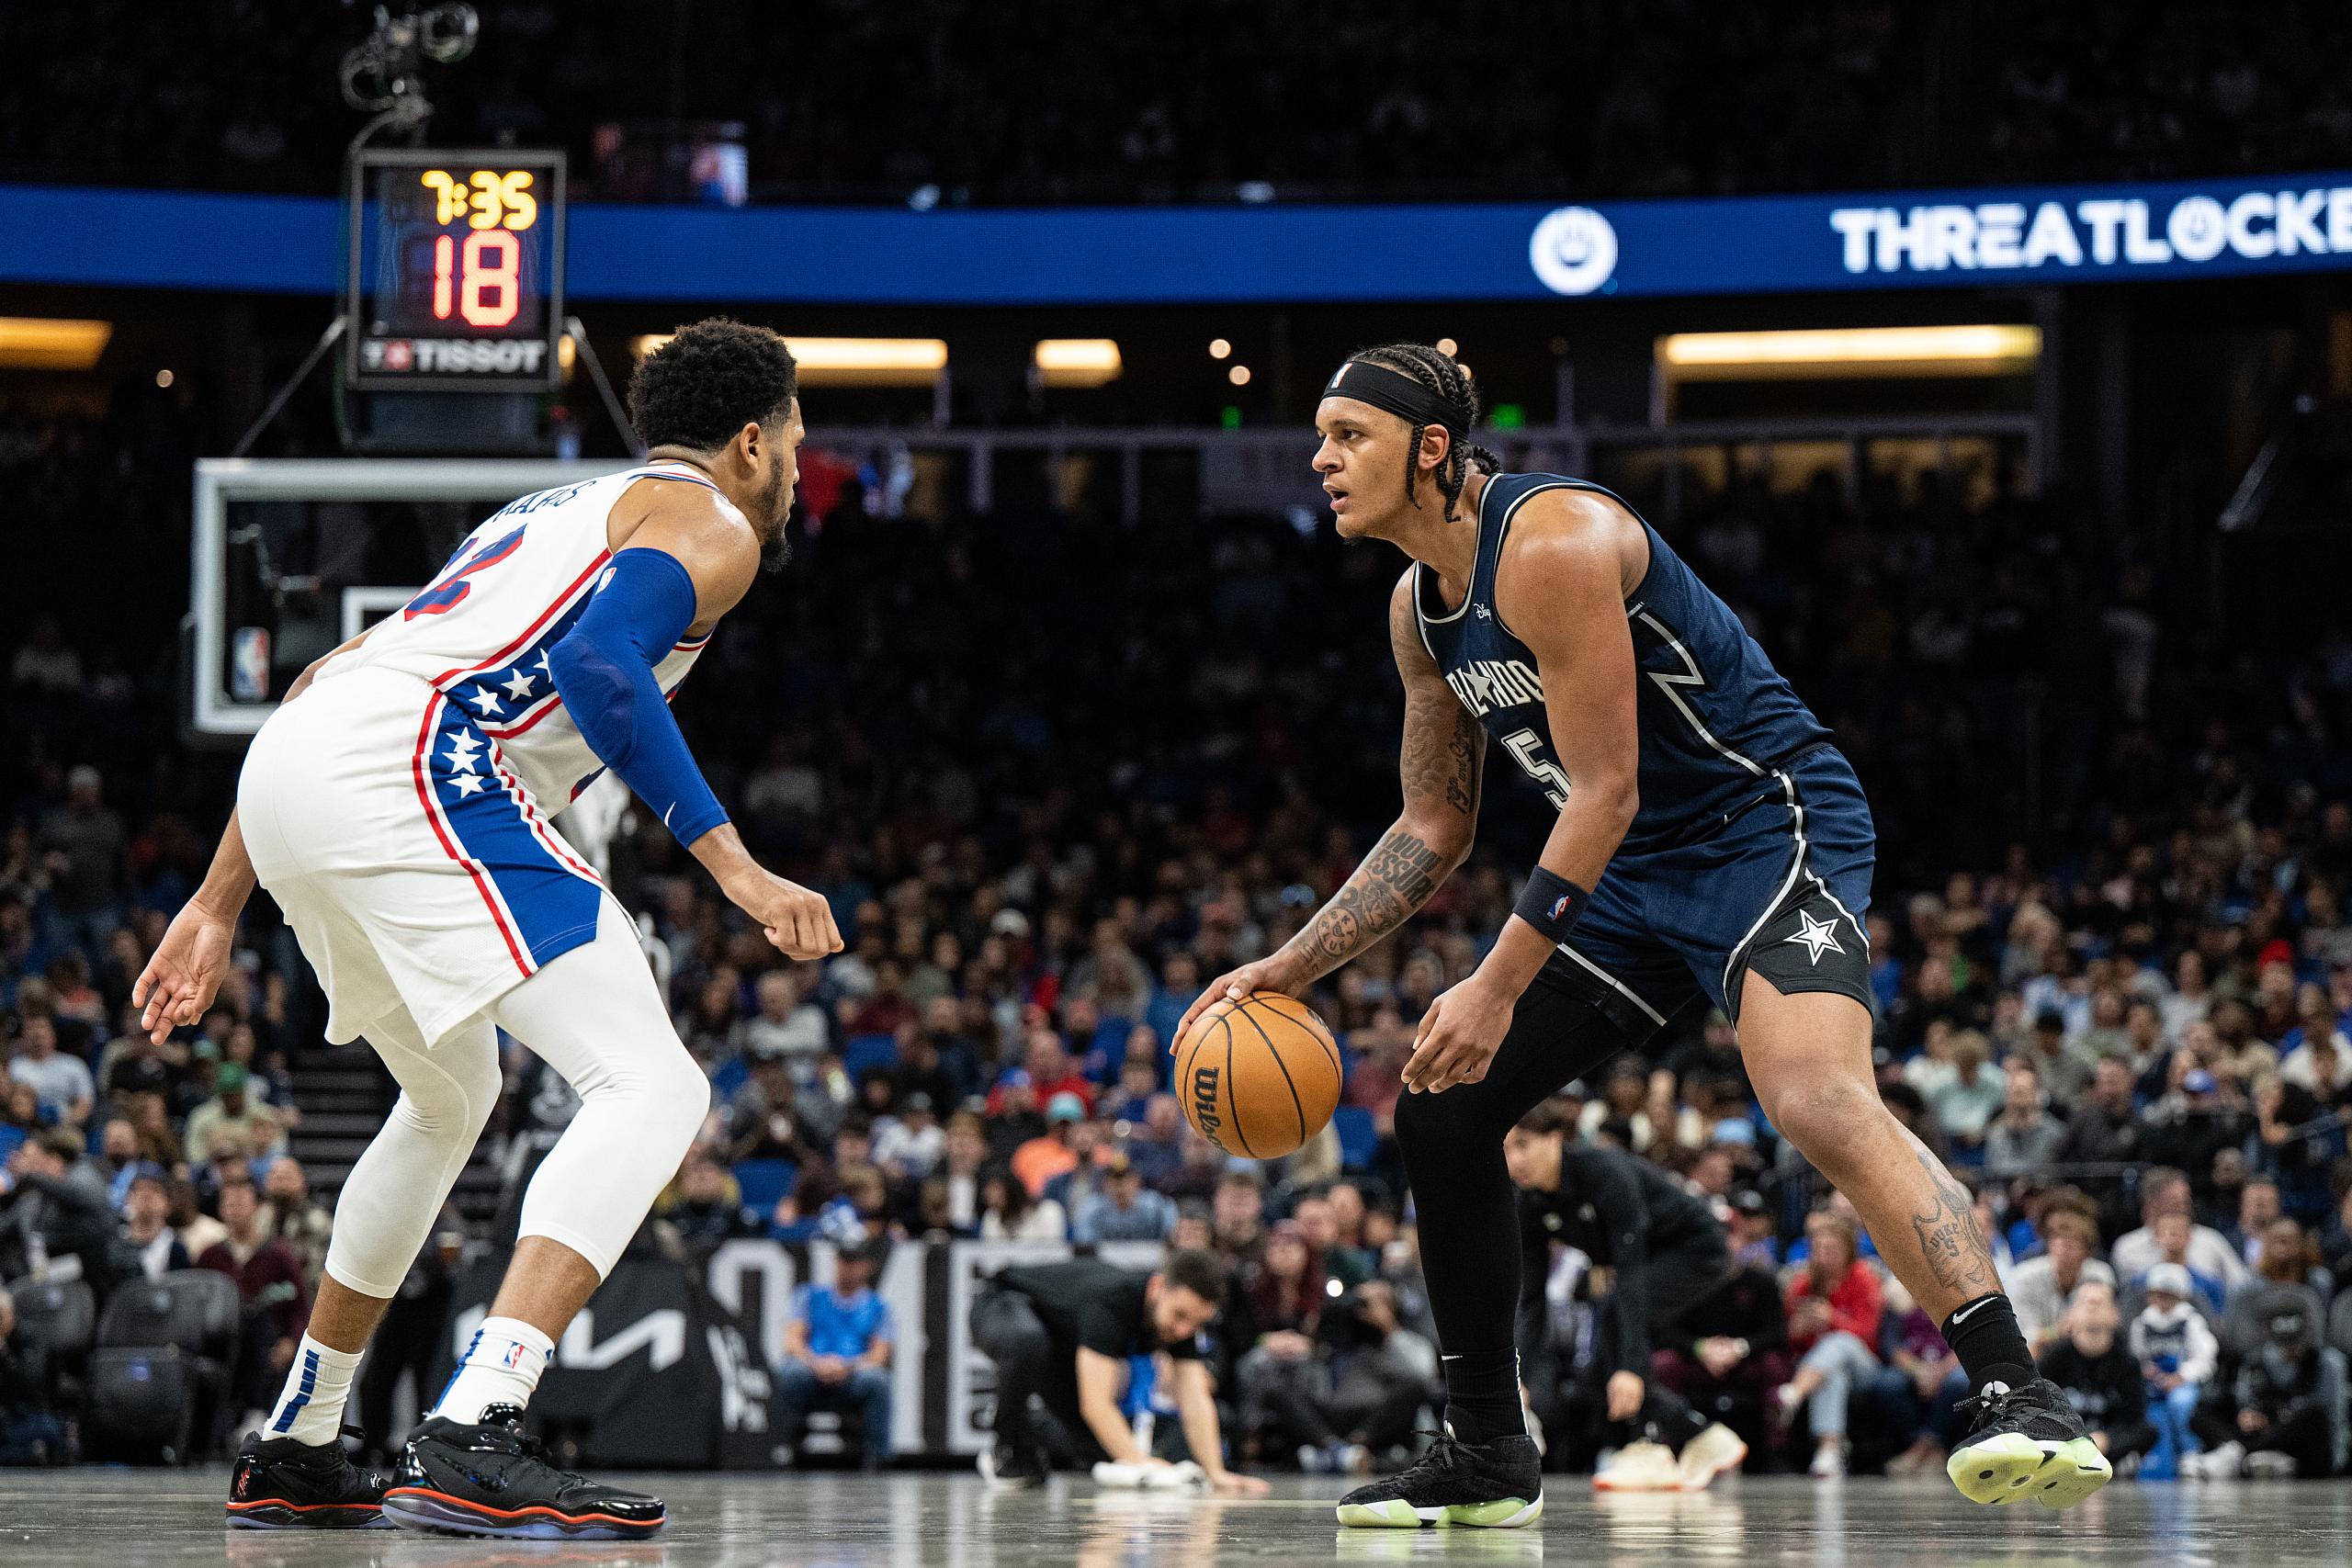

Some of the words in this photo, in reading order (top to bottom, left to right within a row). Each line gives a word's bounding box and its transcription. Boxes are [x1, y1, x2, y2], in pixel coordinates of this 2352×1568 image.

[421, 170, 537, 231] 7:35
[433, 229, 520, 327] 18
[415, 339, 548, 372] TISSOT
[1500, 727, 1572, 812] 5
[1193, 1066, 1234, 1156] Wilso
